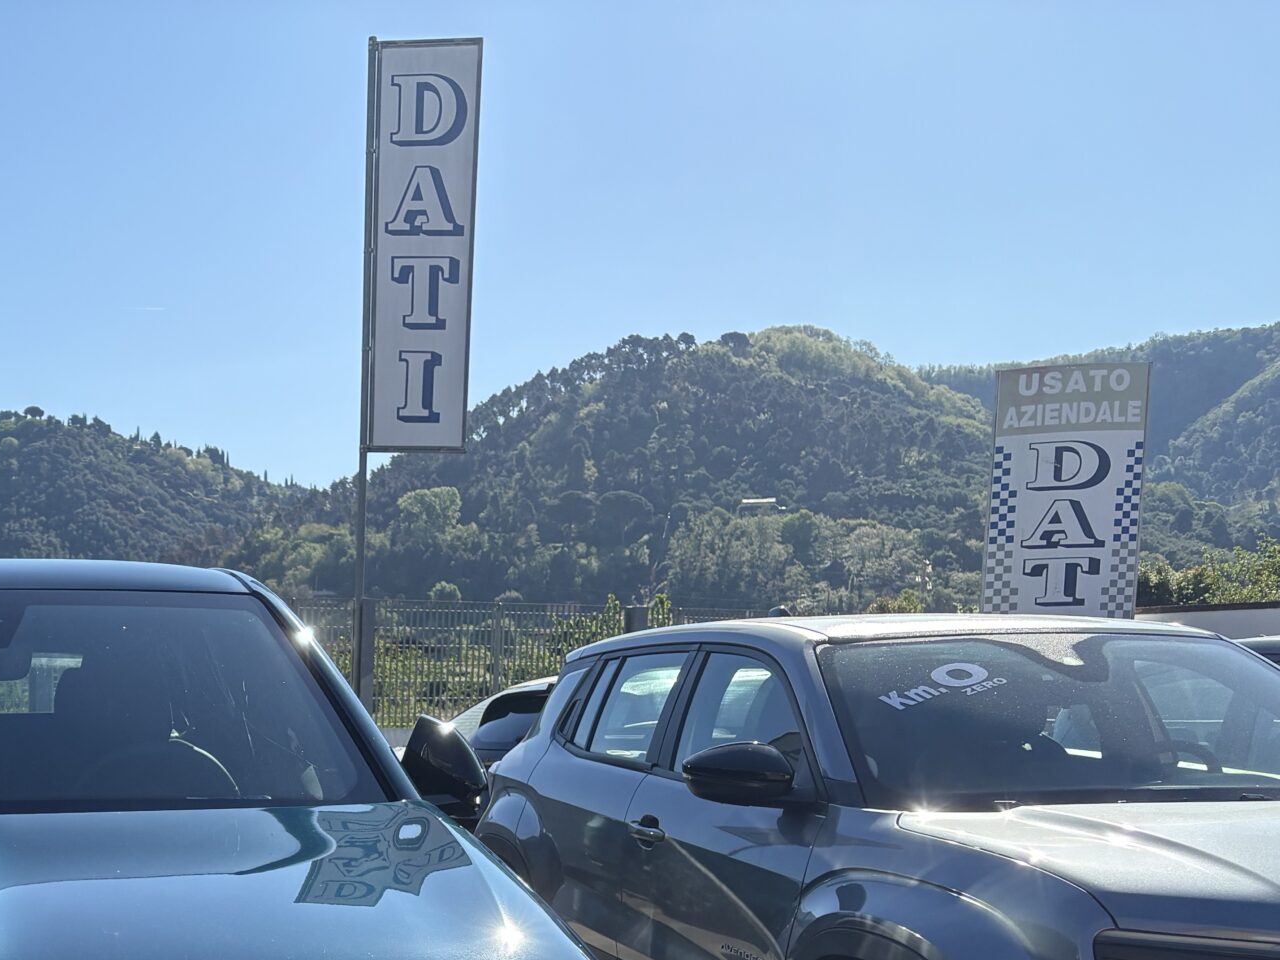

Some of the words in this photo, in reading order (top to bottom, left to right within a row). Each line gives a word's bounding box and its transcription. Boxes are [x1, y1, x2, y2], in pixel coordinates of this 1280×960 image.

[385, 73, 468, 423] DATI
[1019, 368, 1131, 396] USATO
[1003, 400, 1142, 429] AZIENDALE
[1021, 440, 1111, 607] DAT
[961, 677, 1008, 696] ZERO
